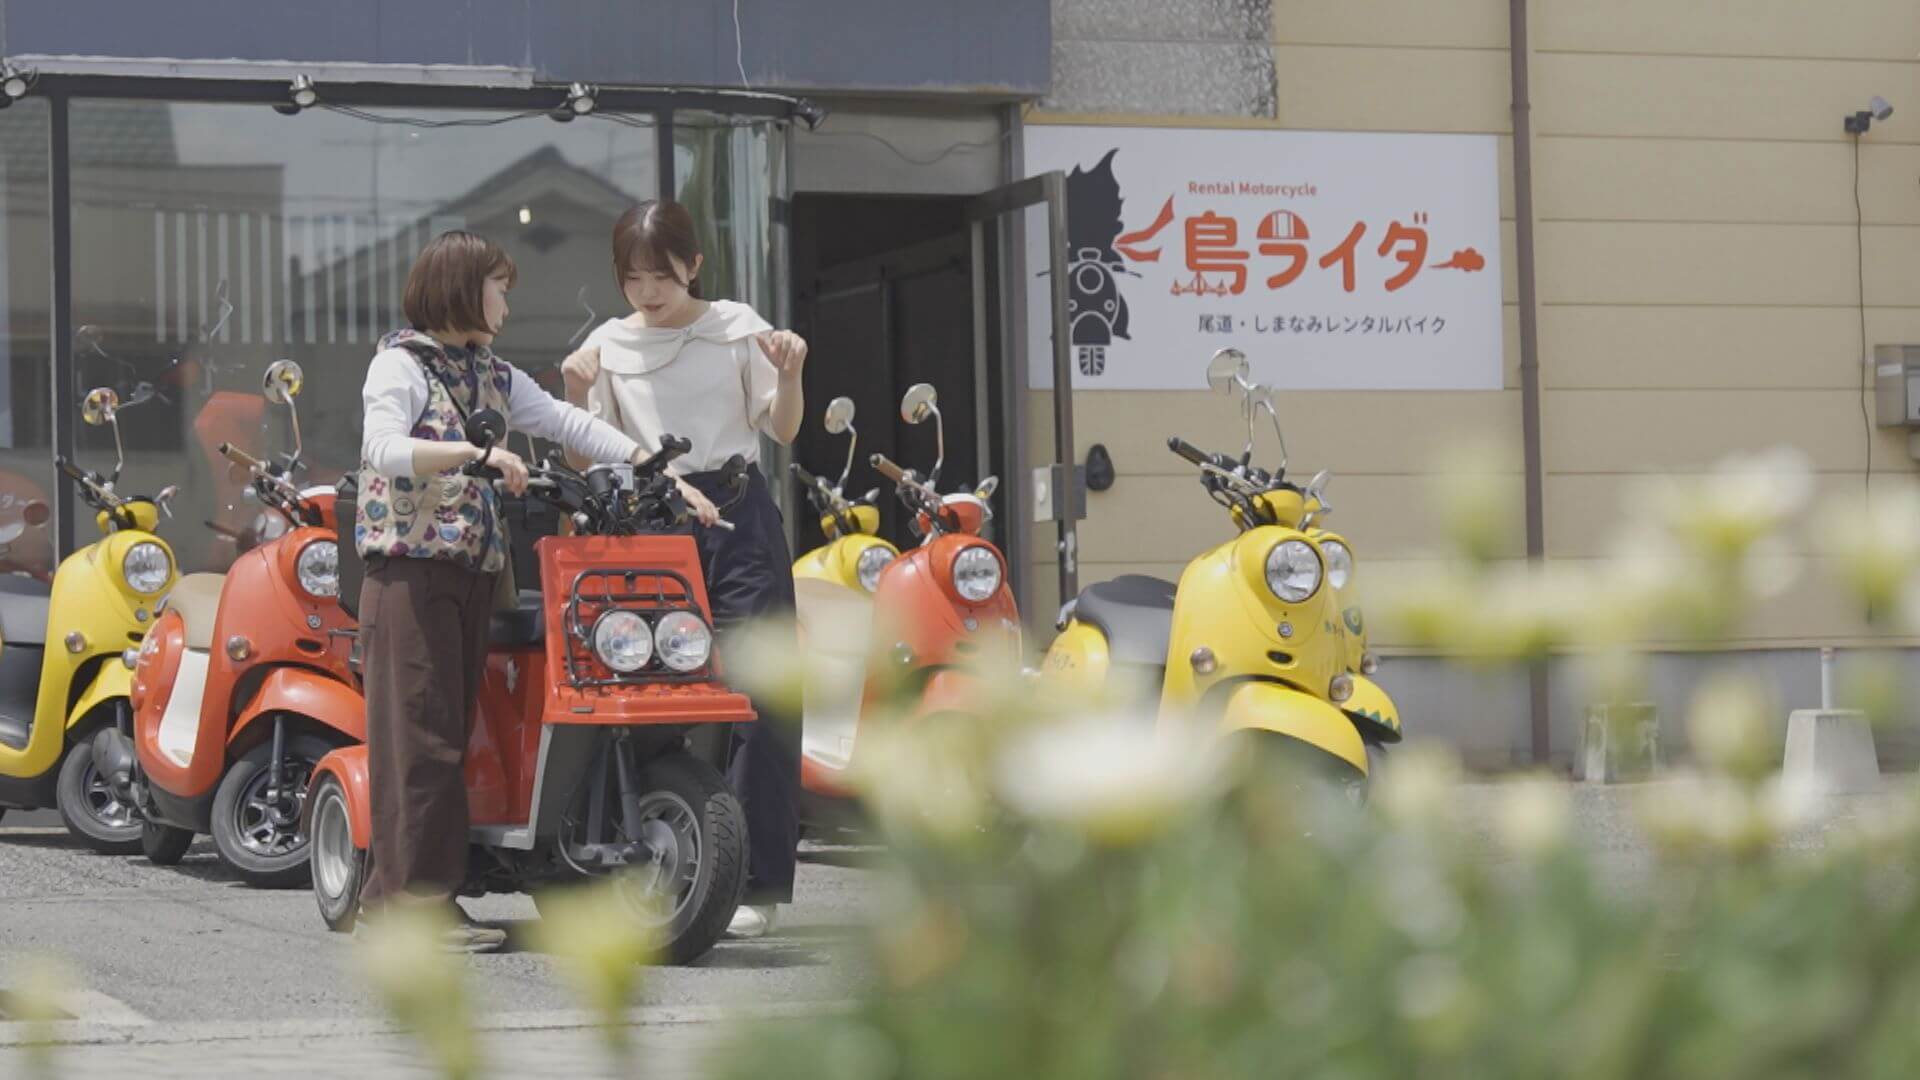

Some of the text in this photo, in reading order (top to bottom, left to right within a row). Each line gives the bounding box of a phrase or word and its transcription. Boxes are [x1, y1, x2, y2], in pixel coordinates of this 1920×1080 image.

[1188, 181, 1318, 197] Rental Motorcycle
[1198, 314, 1446, 334] 尾道・しまなみレンタルバイク
